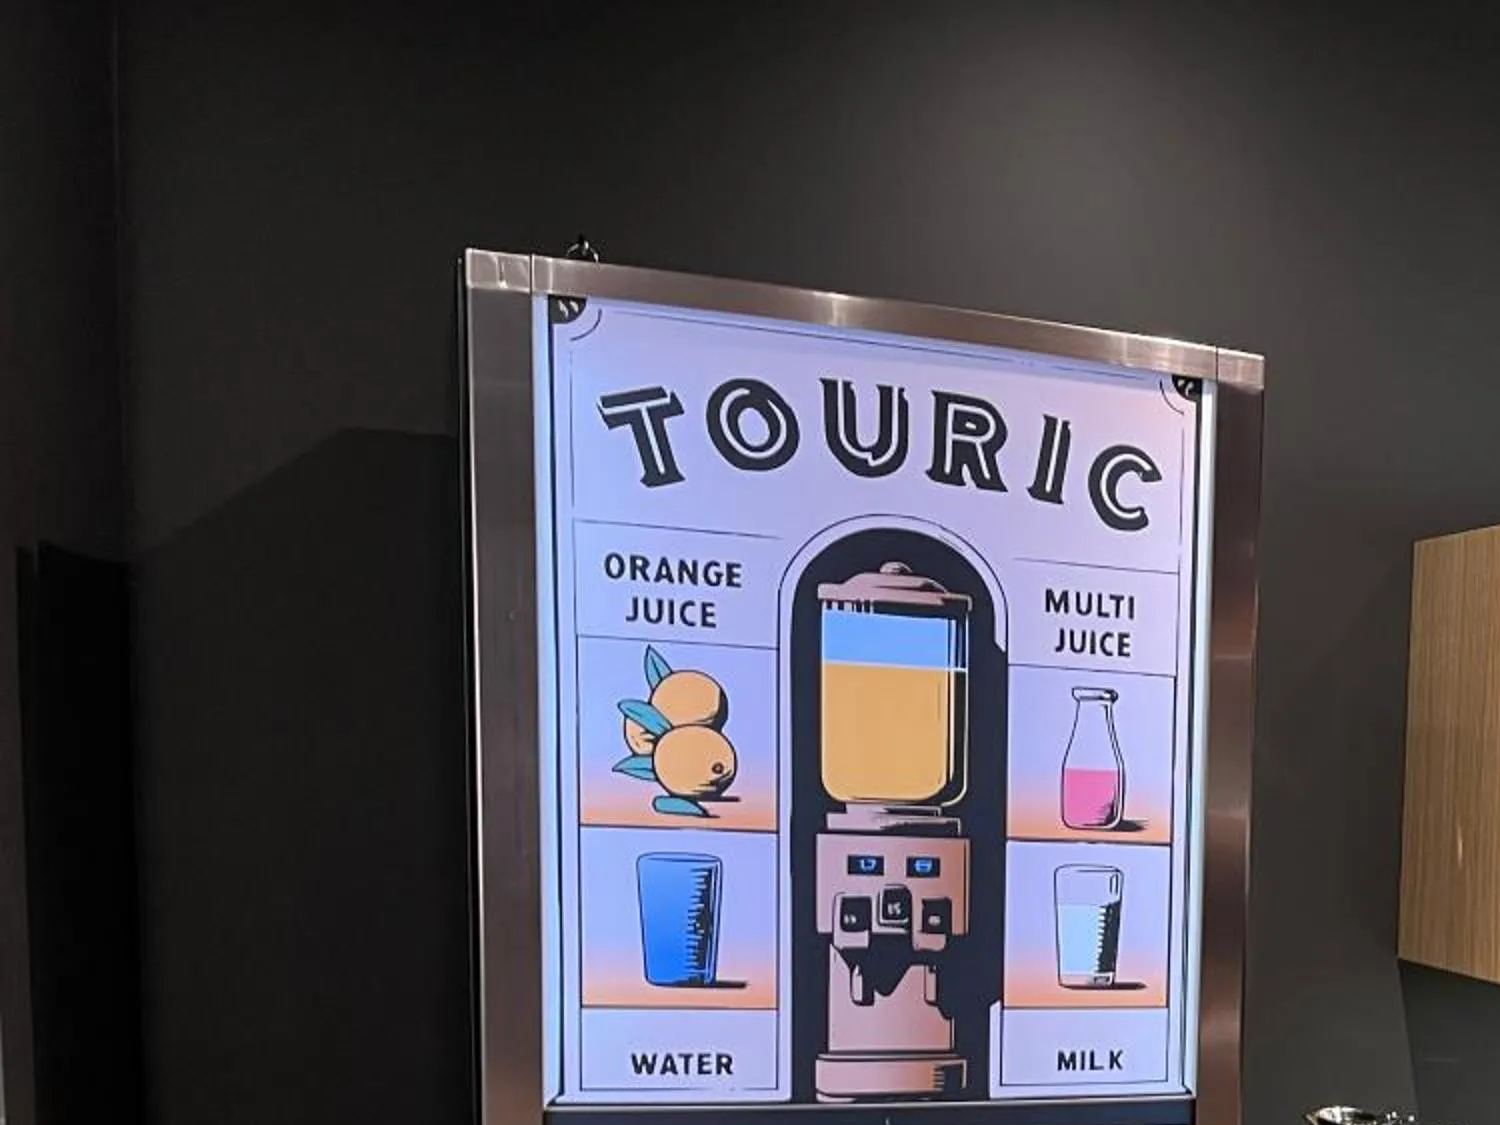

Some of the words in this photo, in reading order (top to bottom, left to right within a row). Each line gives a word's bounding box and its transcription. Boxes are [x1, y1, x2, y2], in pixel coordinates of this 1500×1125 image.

[596, 377, 1164, 532] TOURIC
[603, 552, 743, 590] ORANGE
[625, 597, 718, 630] JUICE
[1044, 587, 1136, 621] MULTI
[1054, 626, 1132, 658] JUICE
[630, 1052, 734, 1076] WATER
[1056, 1049, 1124, 1072] MILK
